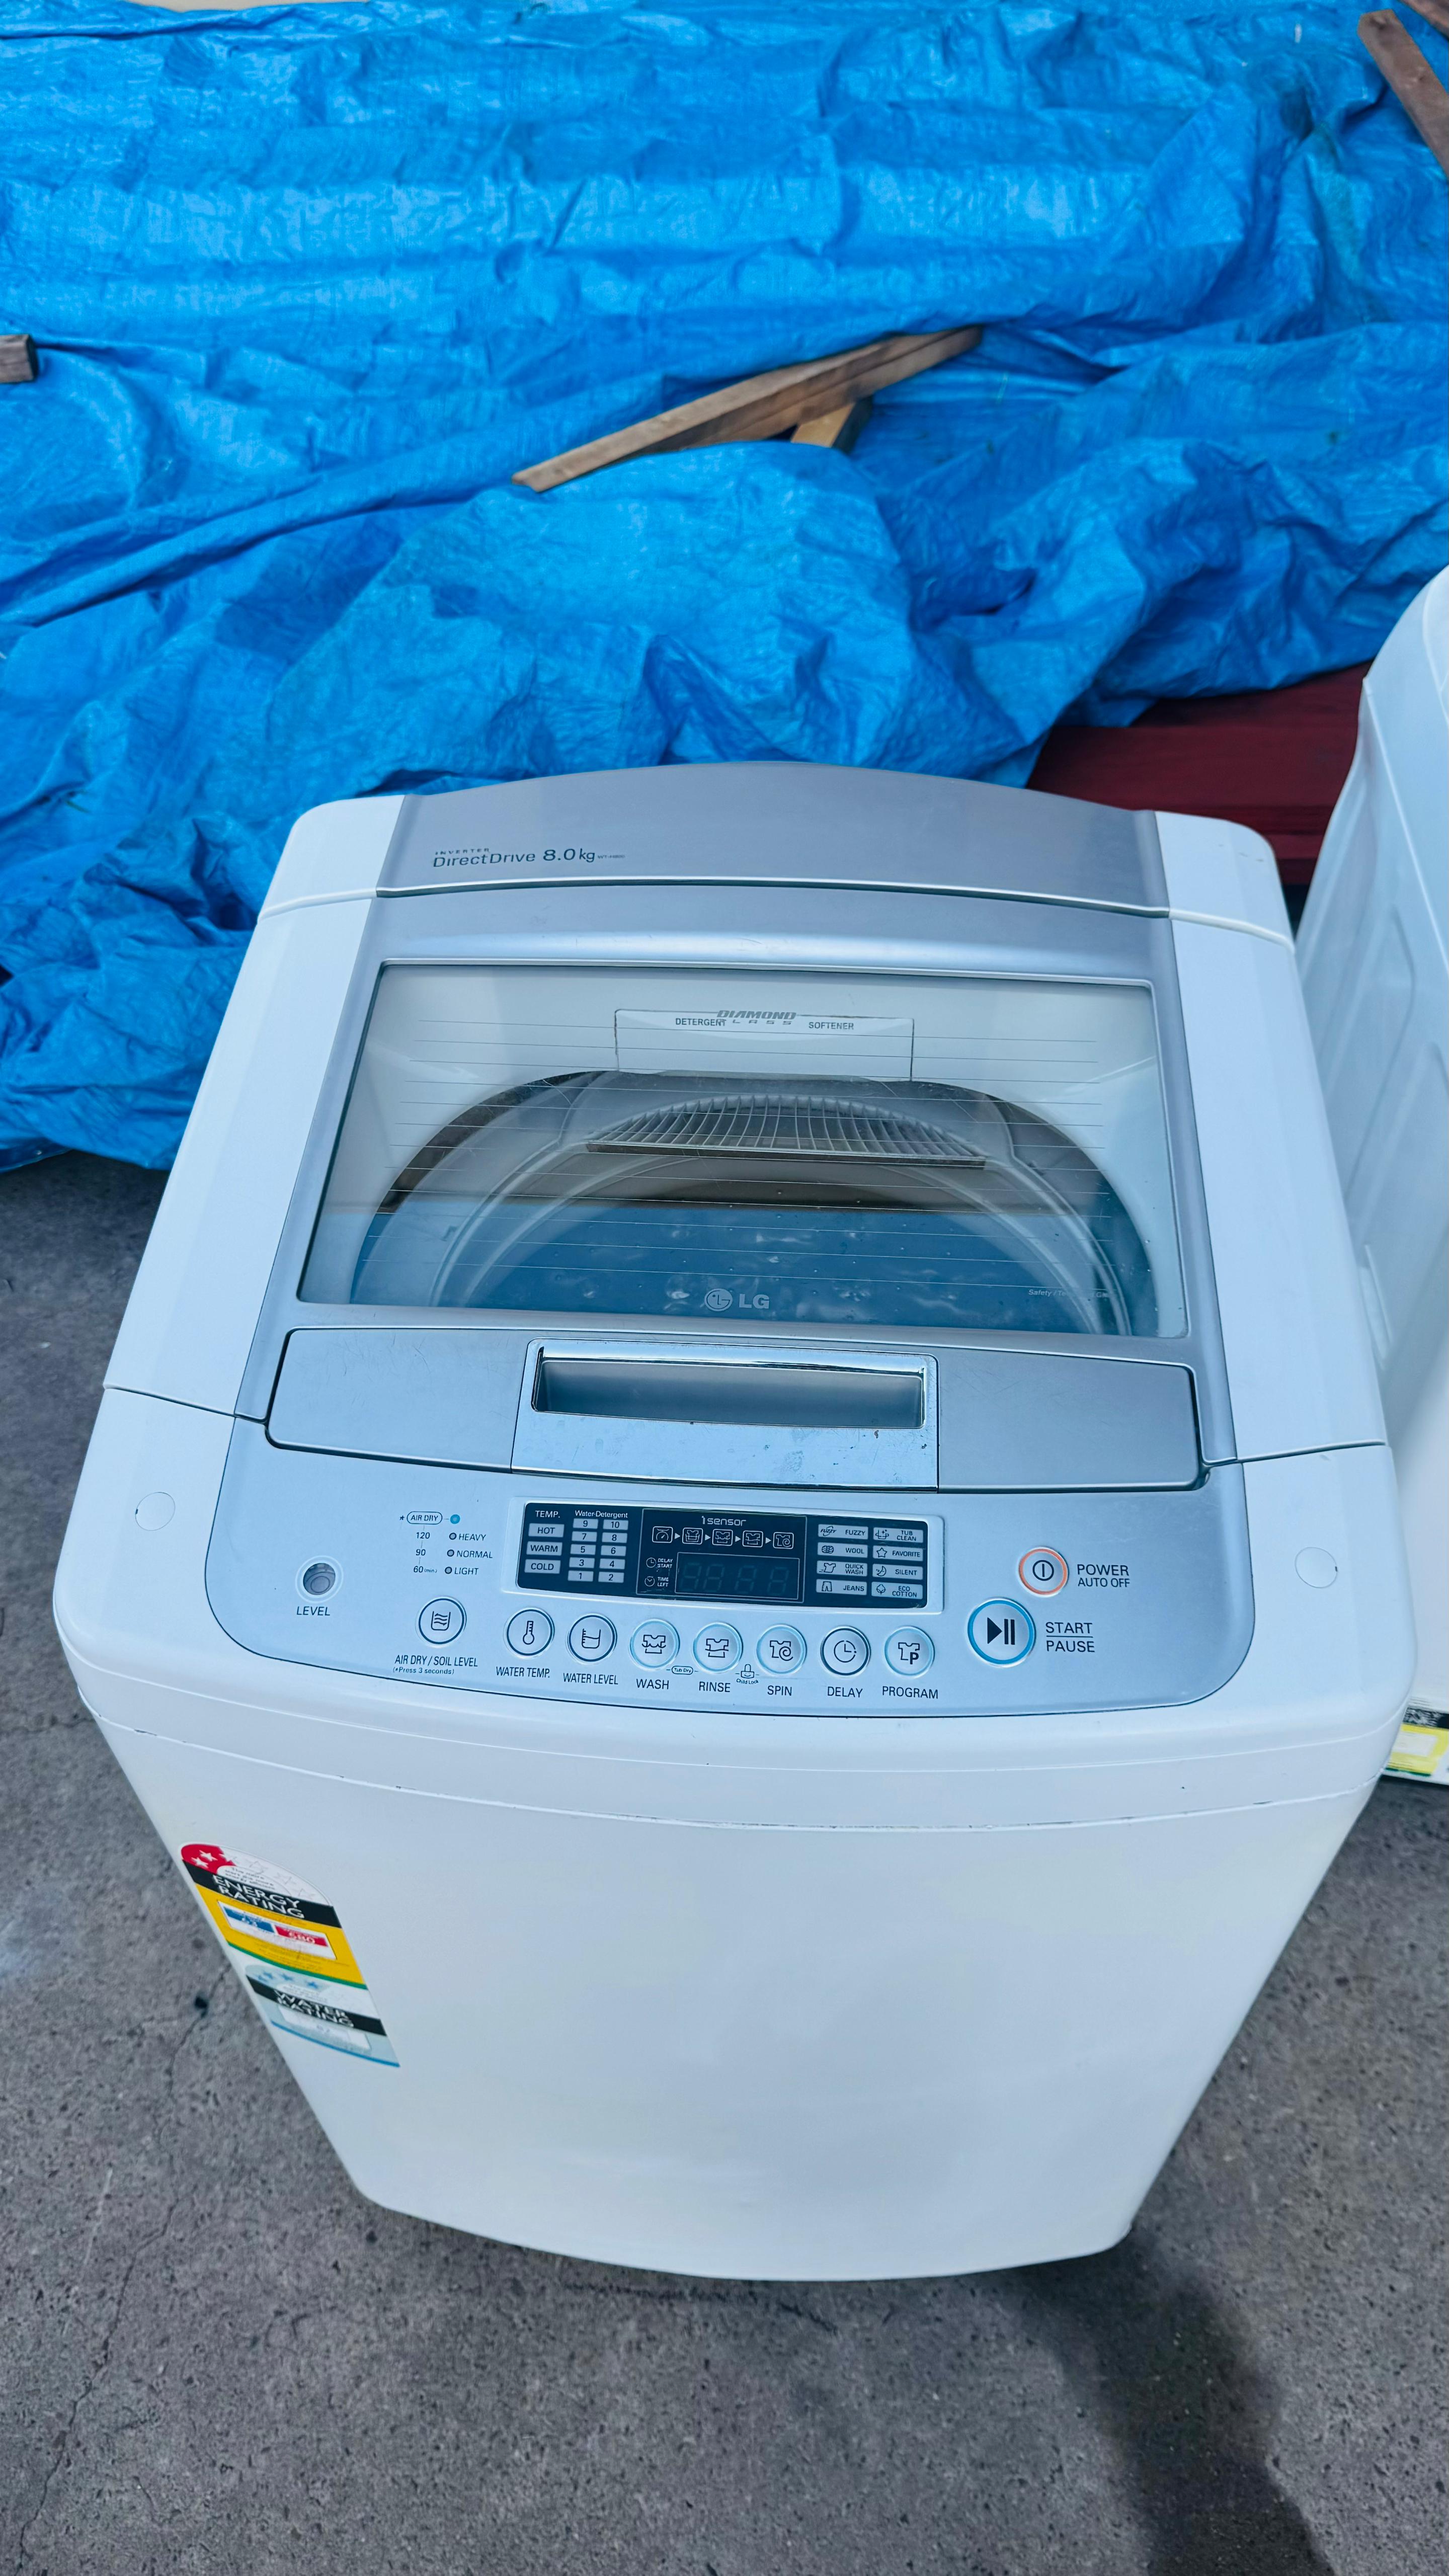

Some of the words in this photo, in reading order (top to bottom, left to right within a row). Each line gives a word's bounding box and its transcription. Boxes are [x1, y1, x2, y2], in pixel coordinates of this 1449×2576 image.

[717, 1010, 796, 1020] DIAMOND
[809, 1022, 854, 1030] SOFTENER
[739, 1294, 770, 1309] LG
[1077, 1564, 1129, 1576] POWER
[1078, 1578, 1107, 1587] AUTO
[1110, 1578, 1130, 1587] OFF
[296, 1606, 331, 1616] LEVEL
[1045, 1622, 1093, 1634] START
[1046, 1640, 1095, 1653] PAUSE
[394, 1655, 408, 1664] AIR
[411, 1655, 427, 1665] DRY
[434, 1656, 452, 1666] SOIL
[454, 1657, 478, 1667] LEVEL
[496, 1666, 524, 1677] WATER
[527, 1667, 550, 1678] TEMP.
[564, 1673, 592, 1683] WATER
[594, 1674, 618, 1685] LEVEL
[636, 1678, 669, 1689] WASH
[699, 1681, 731, 1693] RINSE
[767, 1685, 792, 1697] SPIN
[827, 1686, 863, 1698] DELAY
[882, 1686, 938, 1699] PROGRAM
[213, 1875, 300, 1908] ENERGY
[218, 1885, 304, 1918] RATING
